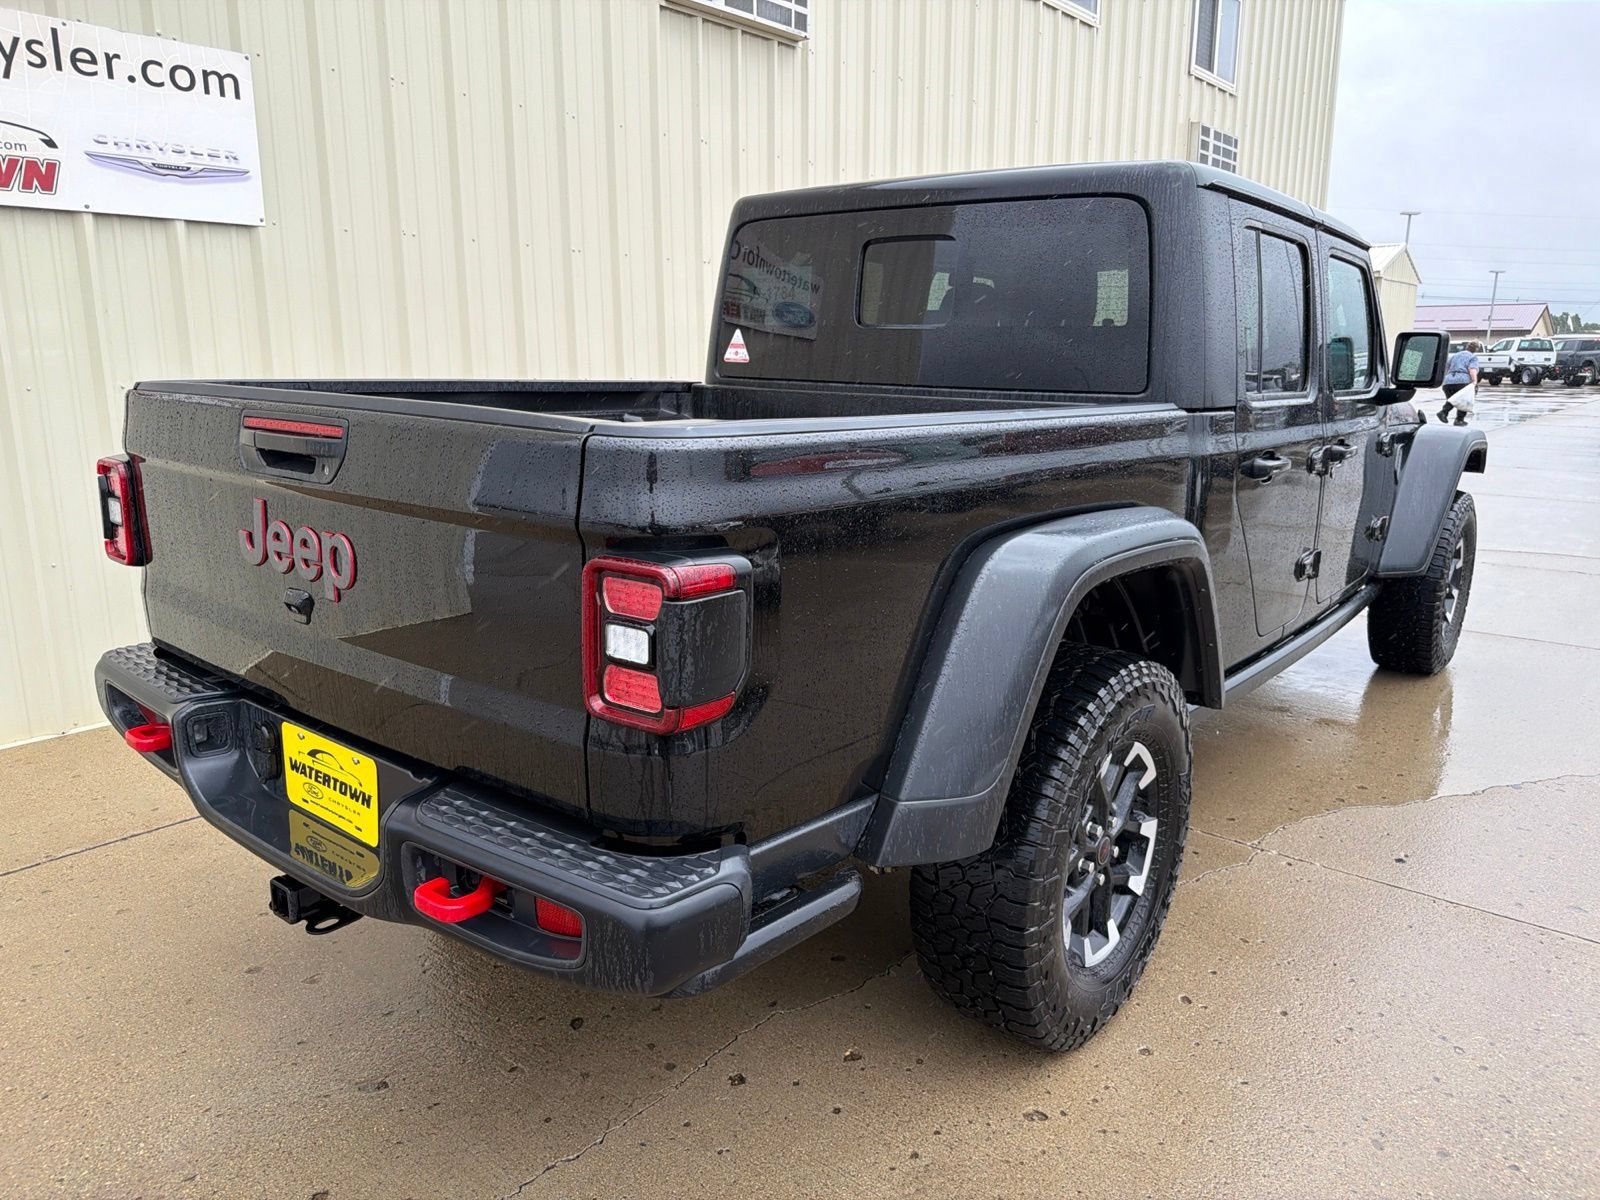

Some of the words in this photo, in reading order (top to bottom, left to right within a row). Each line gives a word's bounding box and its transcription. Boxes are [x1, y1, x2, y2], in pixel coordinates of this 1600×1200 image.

[93, 134, 240, 162] CHRYSLER
[239, 497, 357, 603] Jeep
[289, 756, 373, 809] WATERTOWN
